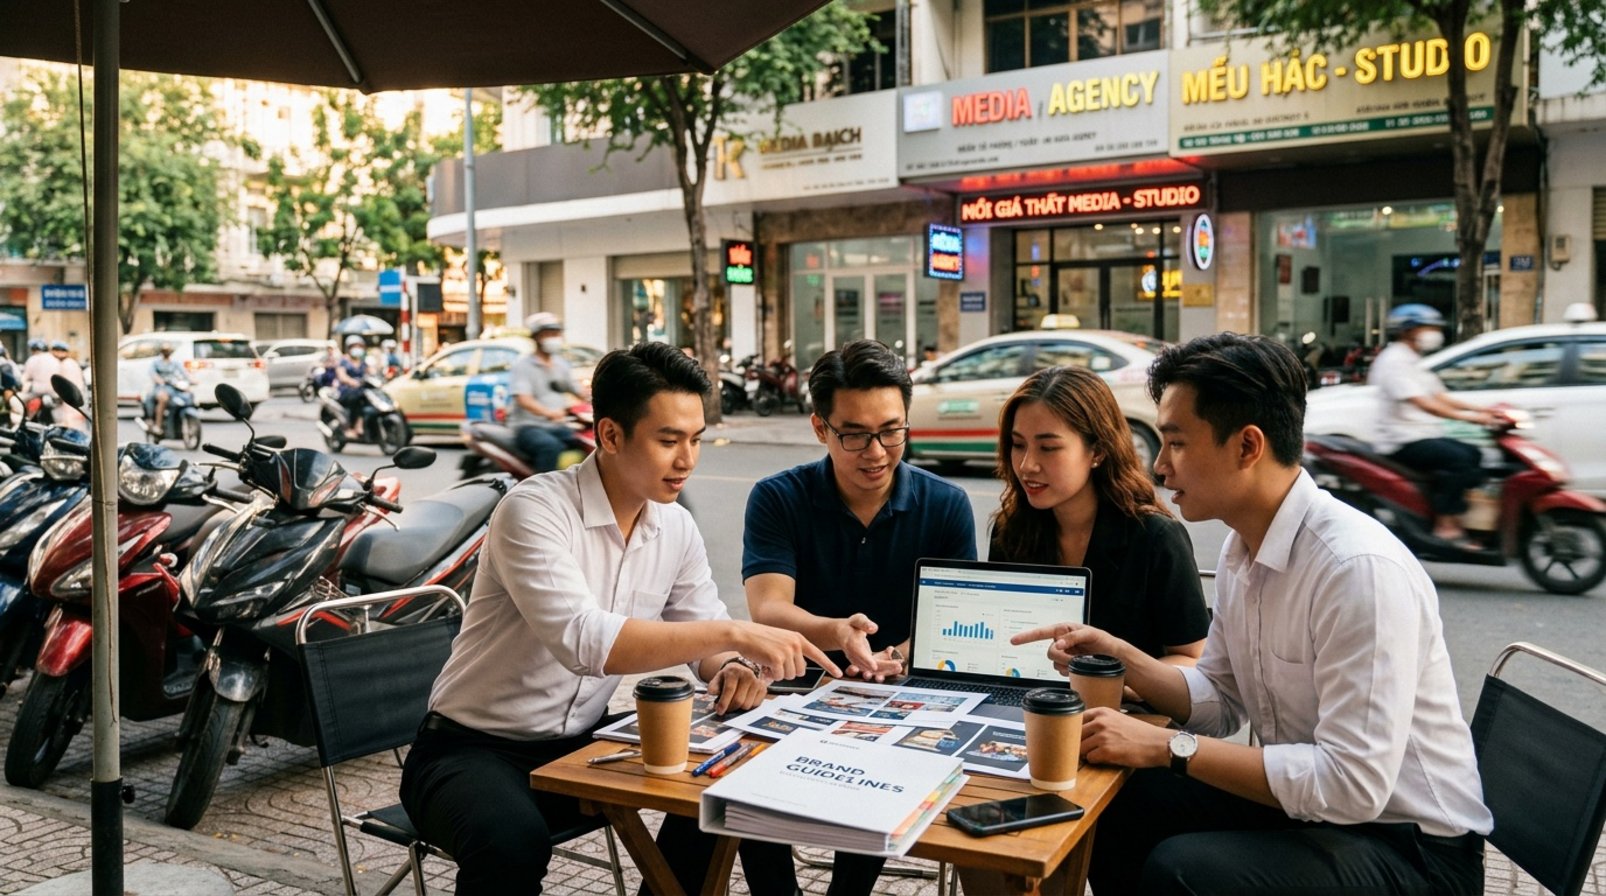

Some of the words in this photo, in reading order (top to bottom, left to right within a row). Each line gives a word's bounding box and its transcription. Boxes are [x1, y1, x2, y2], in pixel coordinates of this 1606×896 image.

[1355, 32, 1491, 85] STUDO
[951, 88, 1032, 127] MEDIA
[1047, 70, 1159, 116] AGENCY
[1068, 191, 1121, 214] MEDIA
[1133, 185, 1201, 209] STUDIO
[795, 756, 865, 775] BRAND
